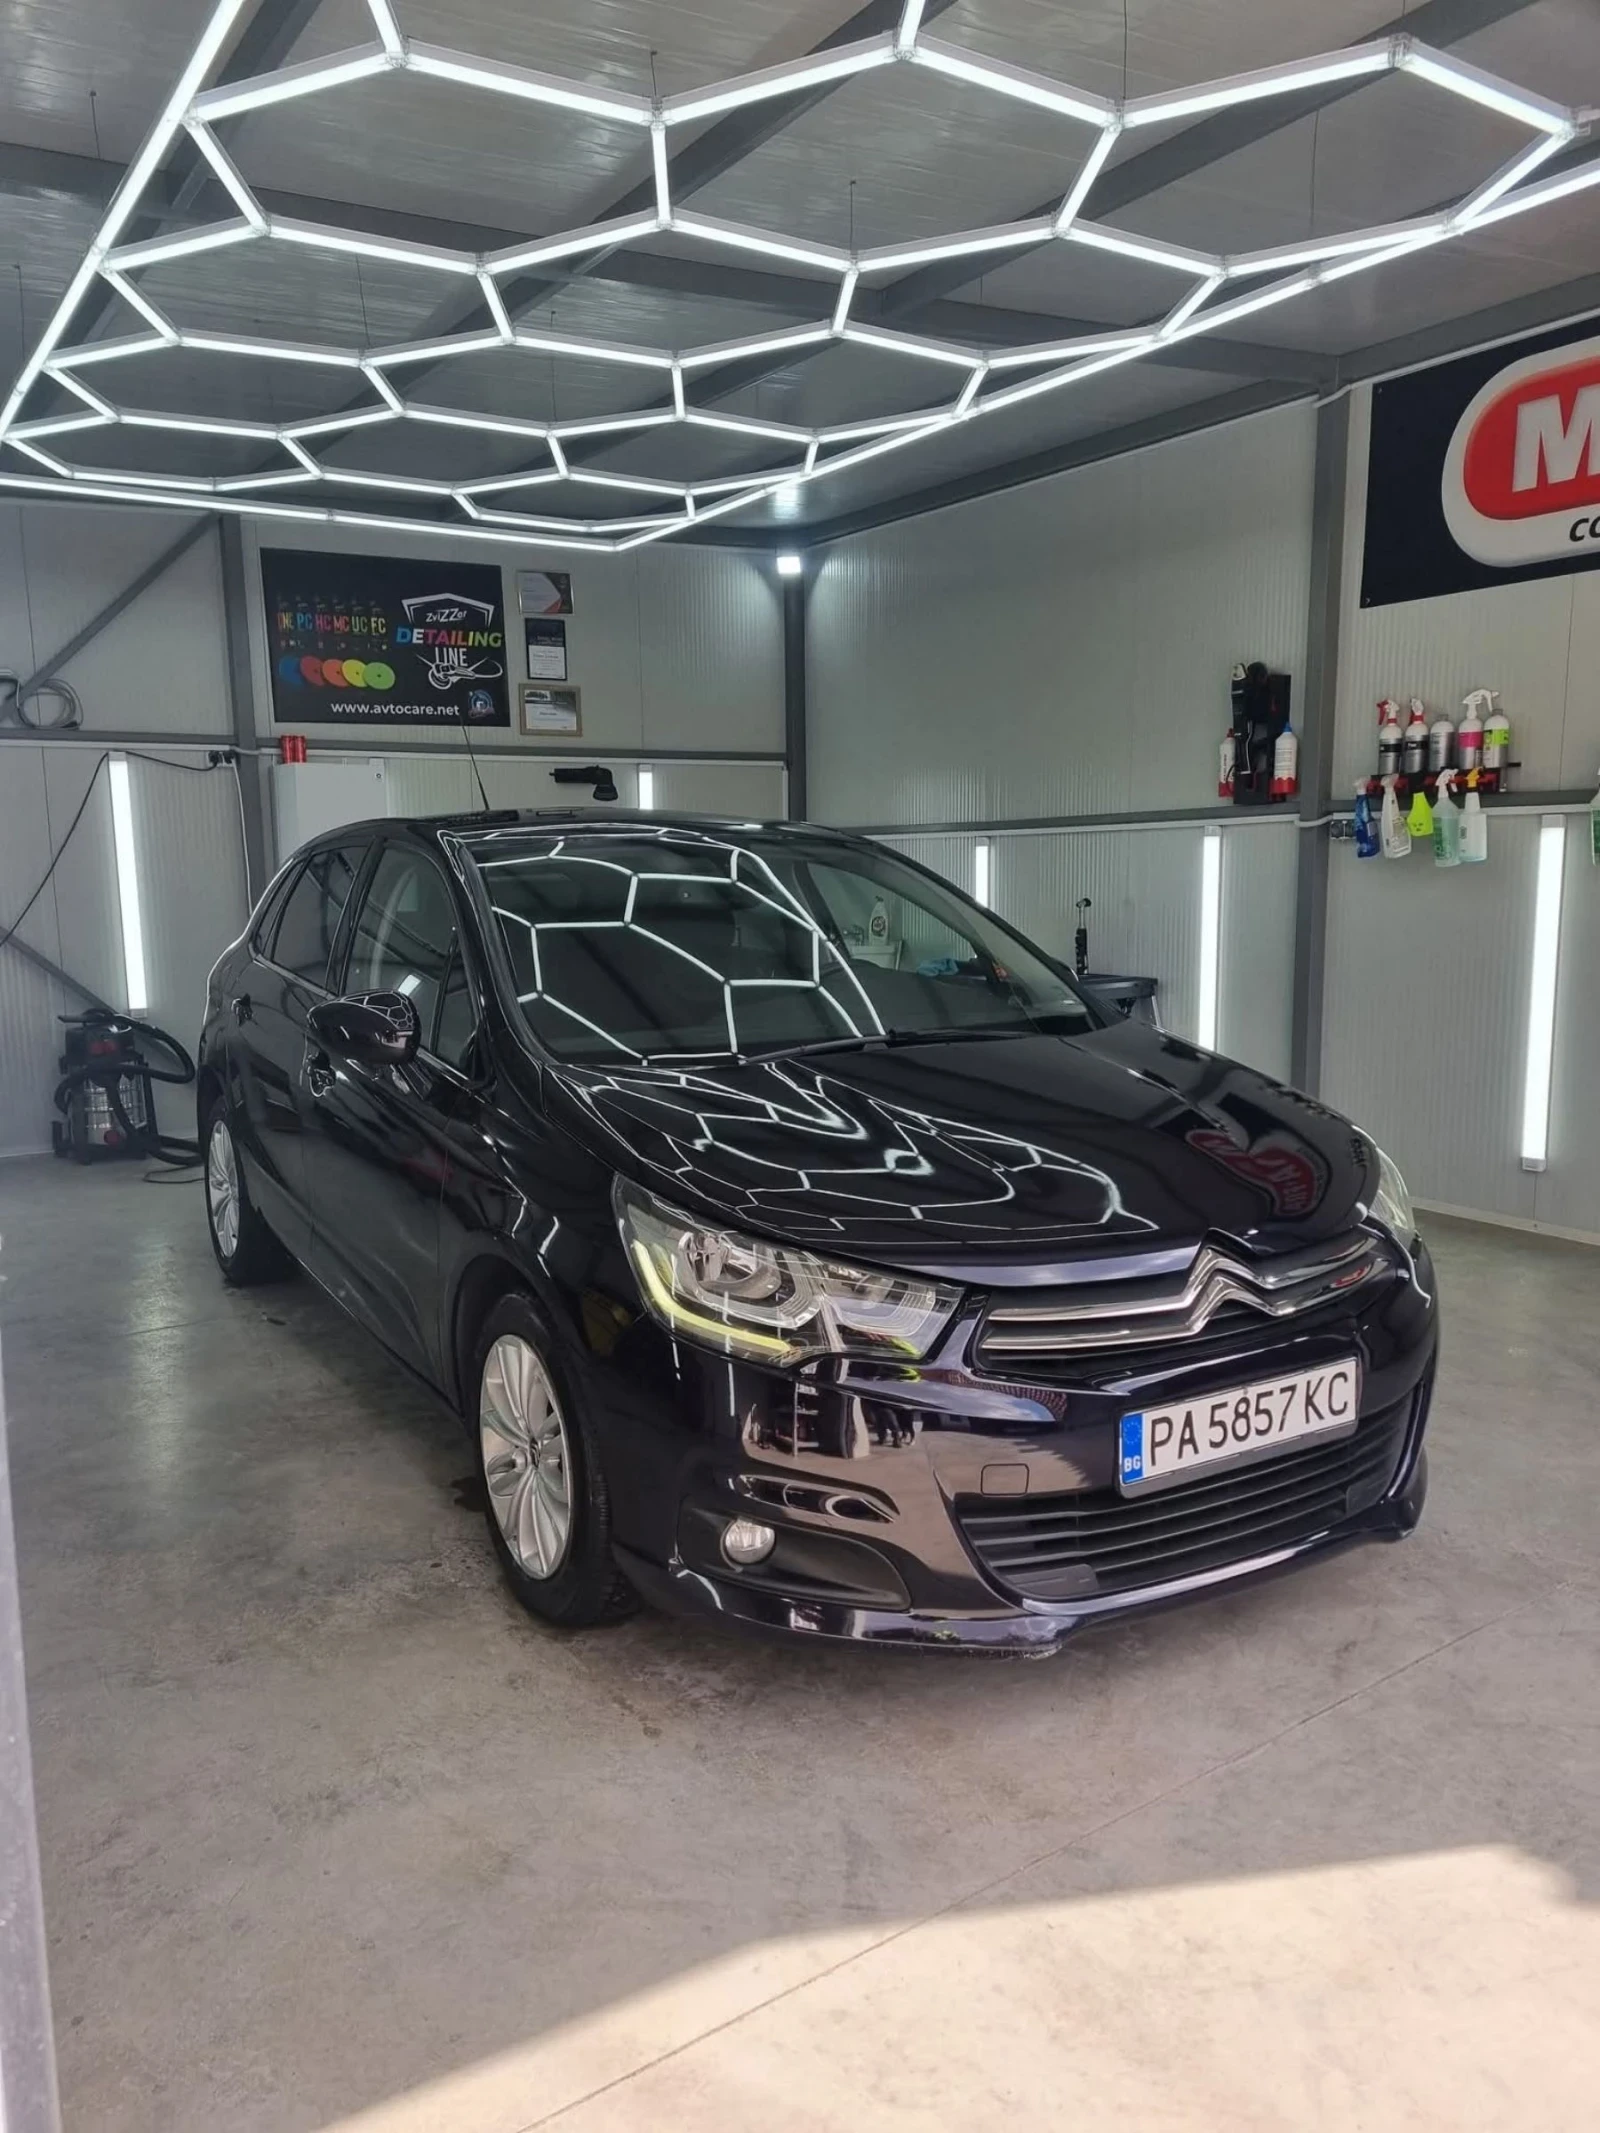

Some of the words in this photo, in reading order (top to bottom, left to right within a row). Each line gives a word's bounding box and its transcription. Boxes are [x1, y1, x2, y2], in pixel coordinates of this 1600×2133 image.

[351, 615, 368, 633] UC
[396, 626, 503, 648] DETAILING
[434, 646, 468, 667] LINE
[331, 703, 460, 716] www.avtocare.net
[1123, 1455, 1142, 1473] BG
